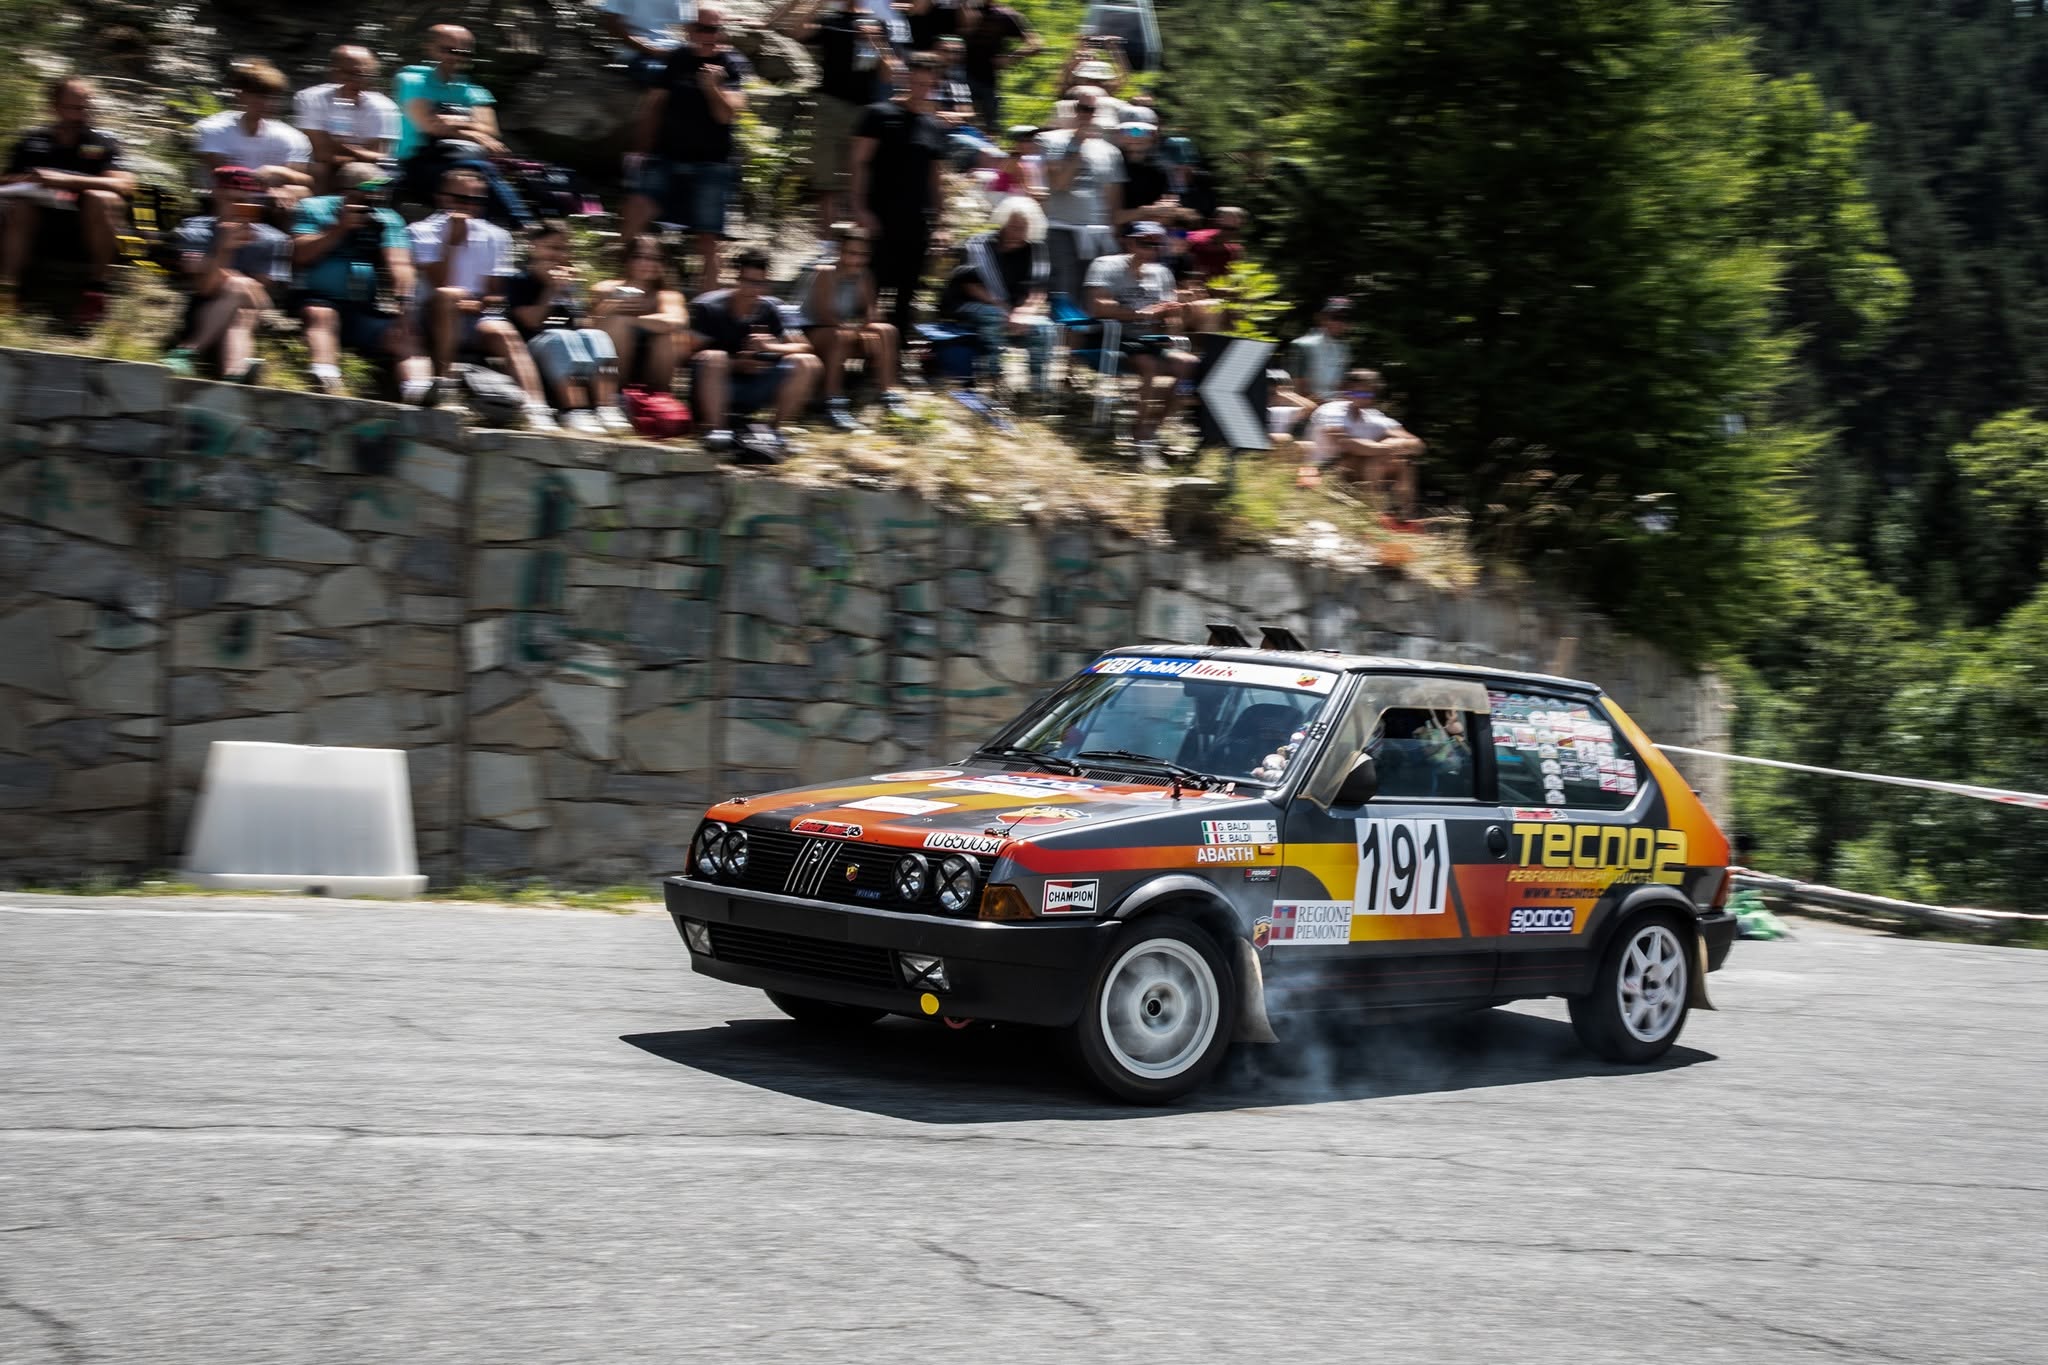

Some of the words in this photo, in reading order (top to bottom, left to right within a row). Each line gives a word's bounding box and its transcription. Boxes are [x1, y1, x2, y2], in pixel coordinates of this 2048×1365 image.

[1227, 822, 1250, 831] BALDI
[1229, 834, 1252, 842] BALDI
[1197, 846, 1255, 863] ABARTH
[1362, 822, 1441, 911] 191
[1048, 890, 1093, 903] CHAMPION
[1298, 906, 1352, 924] REGIONE
[1511, 909, 1574, 933] sparco
[1295, 924, 1350, 940] PIEMONTE
